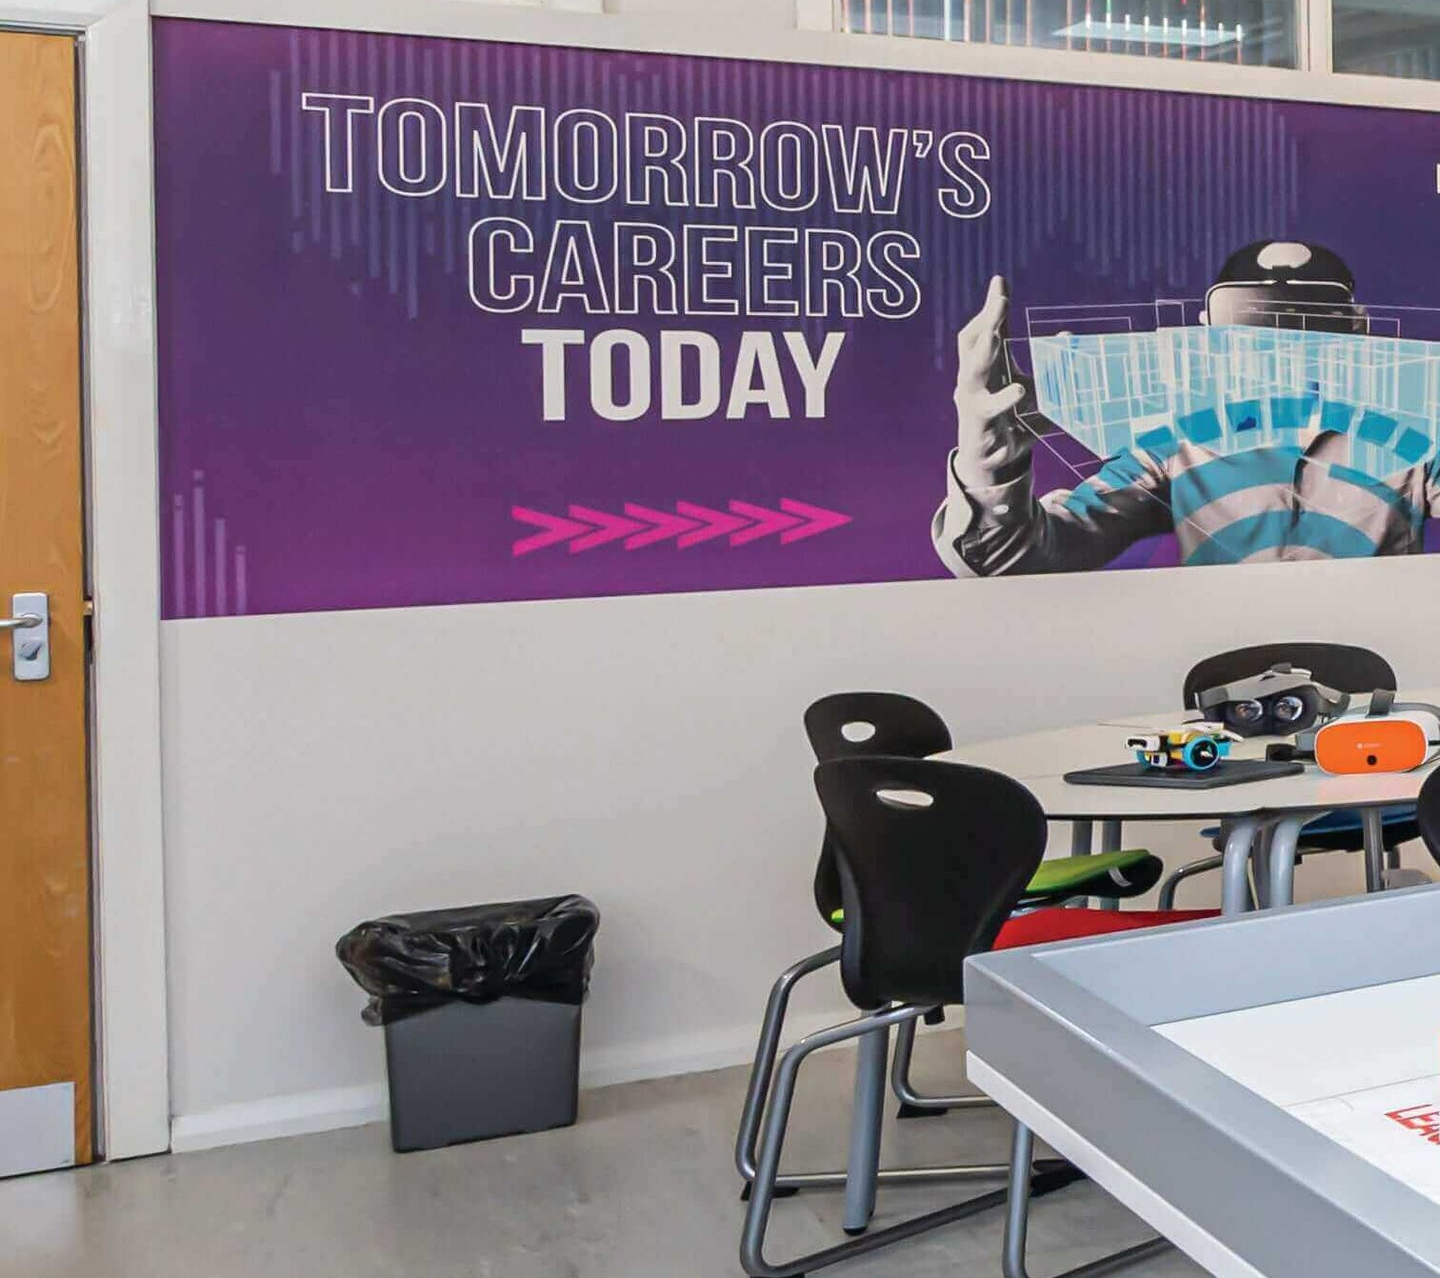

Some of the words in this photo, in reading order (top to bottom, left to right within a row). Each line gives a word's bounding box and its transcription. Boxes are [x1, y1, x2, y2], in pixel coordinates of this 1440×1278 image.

[302, 92, 991, 219] TOMORROW'S
[467, 215, 922, 320] CAREERS
[520, 327, 846, 421] TODAY
